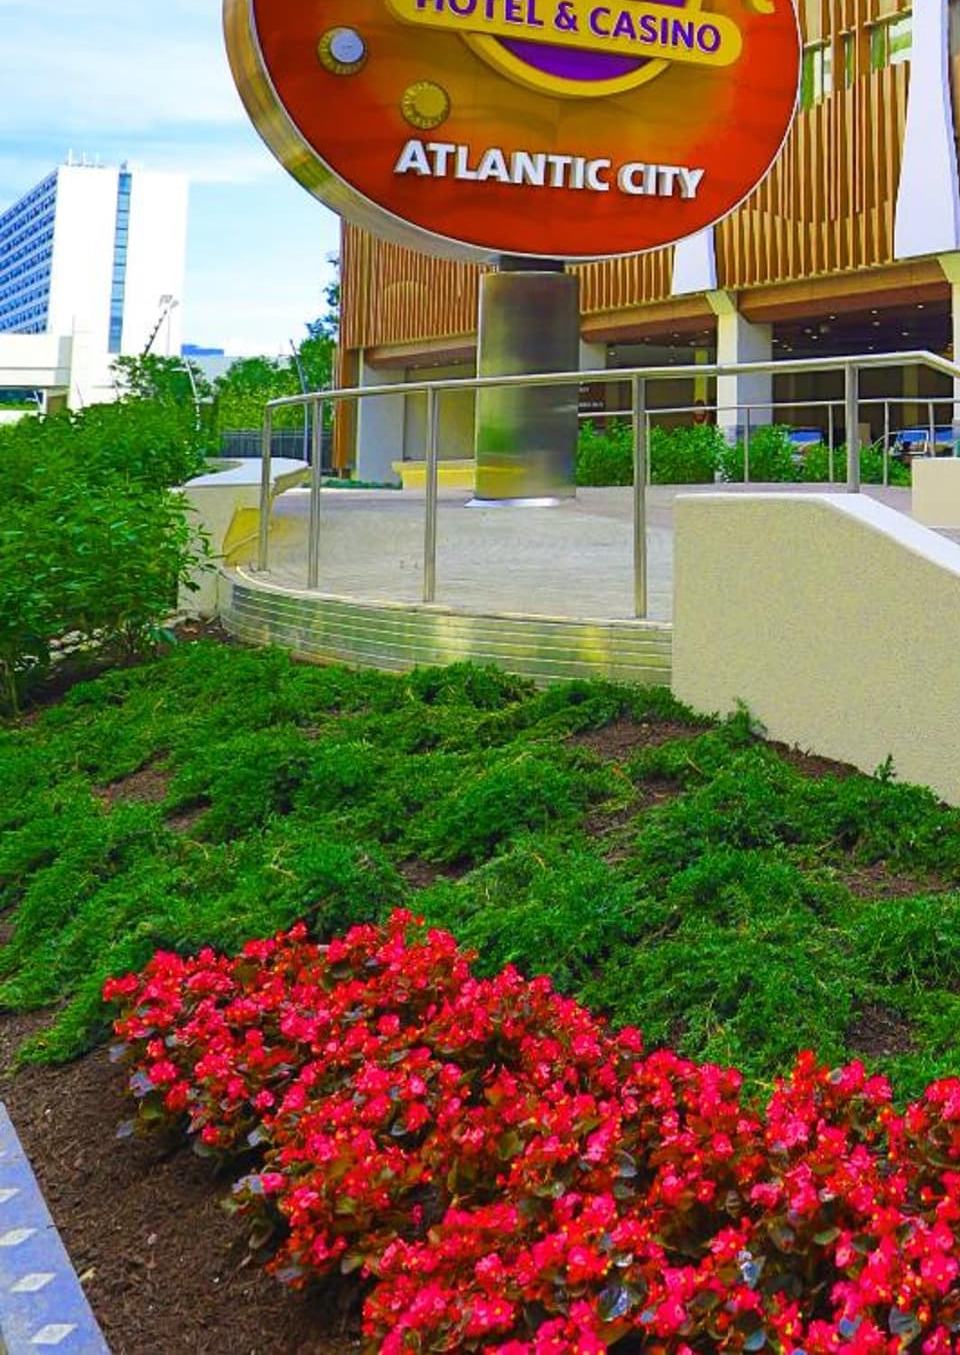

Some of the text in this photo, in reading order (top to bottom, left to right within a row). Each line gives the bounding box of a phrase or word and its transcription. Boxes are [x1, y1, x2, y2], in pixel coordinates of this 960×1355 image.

[554, 1, 580, 32] &
[589, 6, 722, 53] CASINO
[394, 139, 705, 199] ATLANTIC CITY
